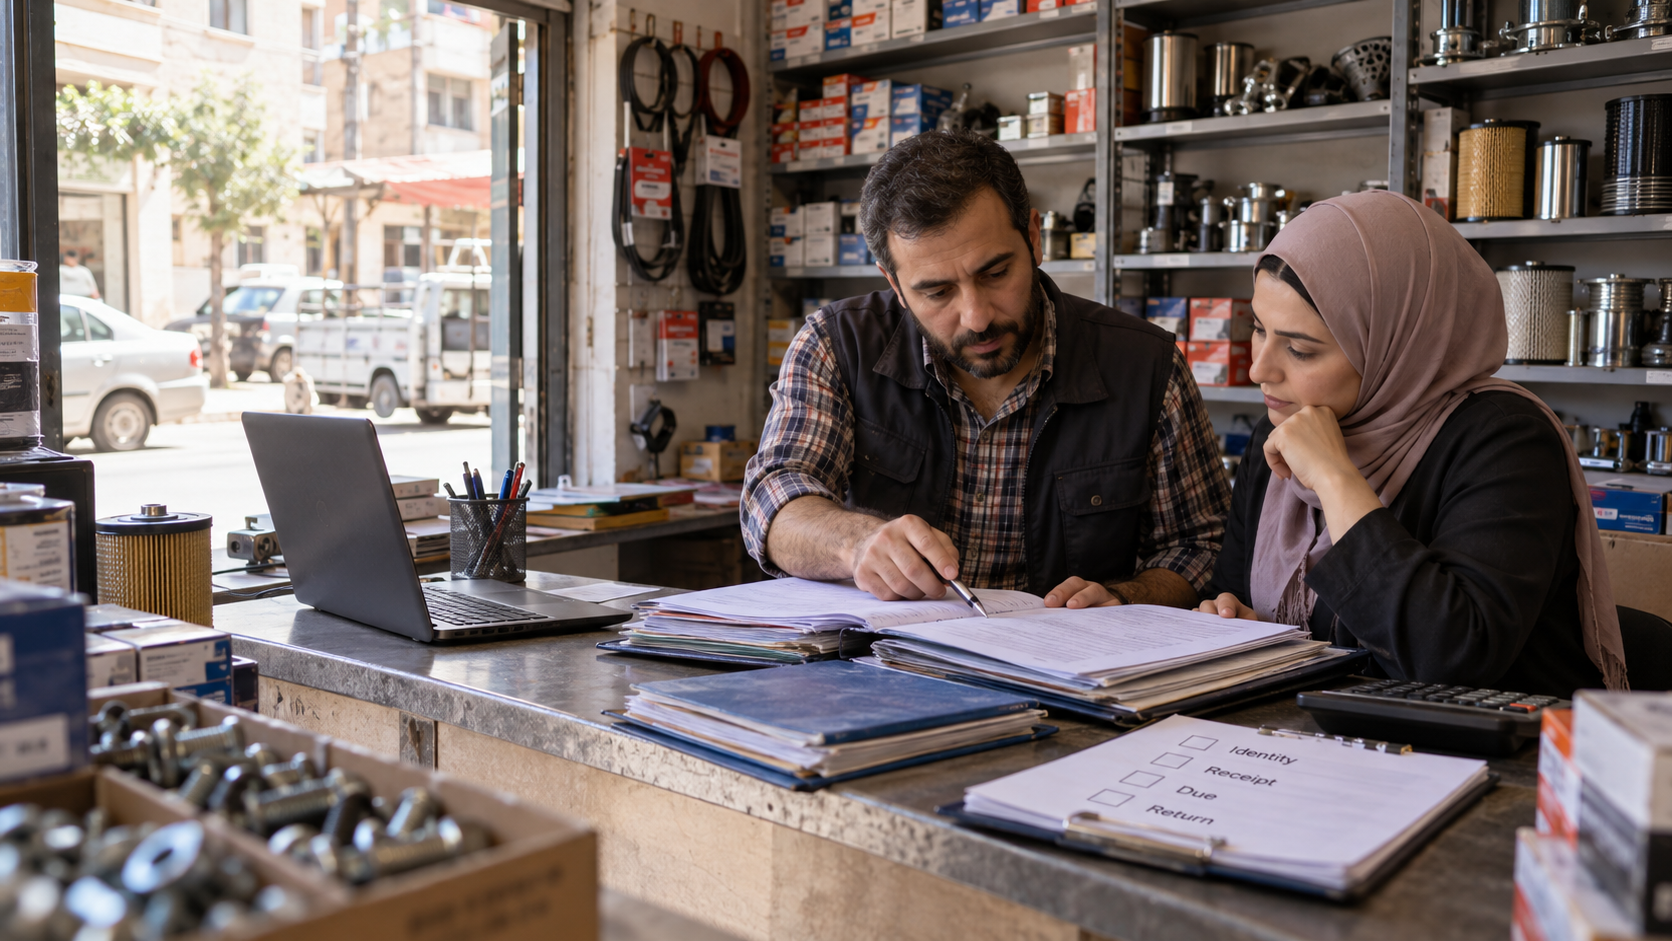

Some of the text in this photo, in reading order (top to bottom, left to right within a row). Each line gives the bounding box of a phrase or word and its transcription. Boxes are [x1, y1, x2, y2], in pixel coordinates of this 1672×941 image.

[1229, 745, 1298, 766] Identity
[1204, 765, 1277, 787] Receipt
[1175, 785, 1218, 801] Due
[1145, 804, 1215, 826] Return
